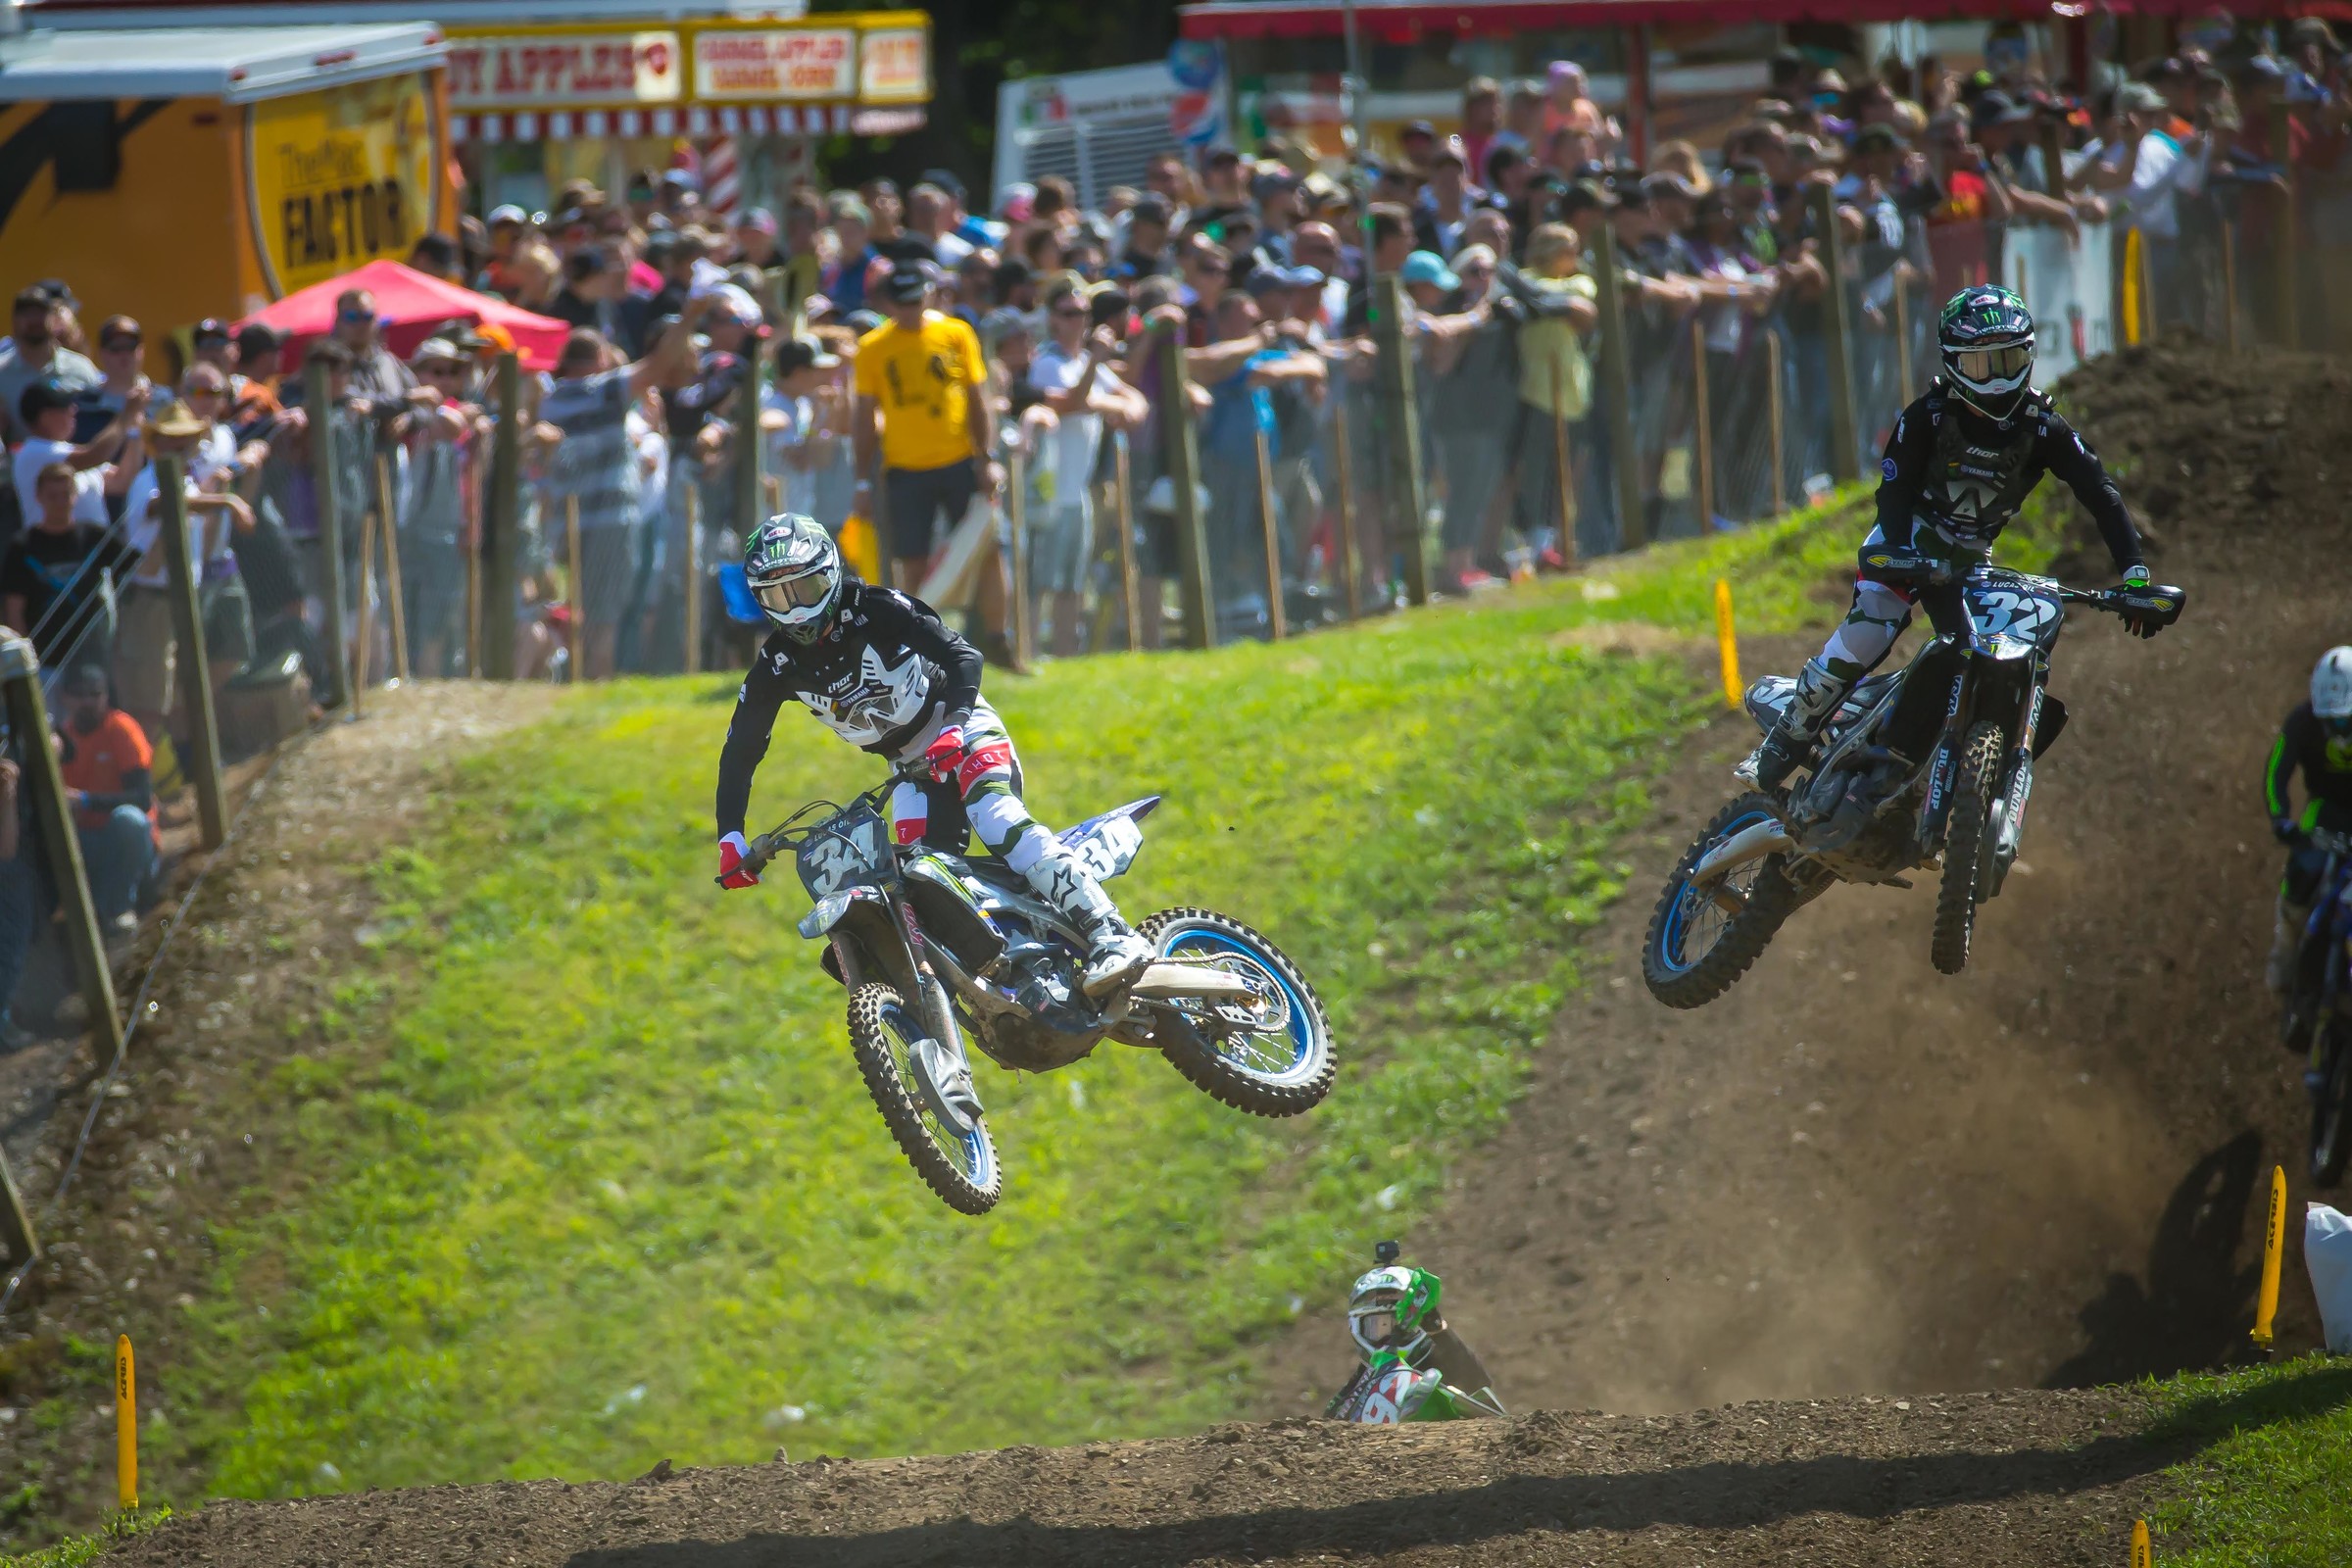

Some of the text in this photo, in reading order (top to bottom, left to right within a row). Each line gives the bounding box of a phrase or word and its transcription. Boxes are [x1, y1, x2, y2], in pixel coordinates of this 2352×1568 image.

[495, 43, 637, 93] APPLES
[281, 175, 409, 270] FACTOR
[1966, 446, 1999, 458] thor
[768, 529, 787, 538] BELL
[1973, 591, 2057, 642] 32
[828, 671, 854, 694] thor
[847, 687, 871, 705] YAMAHA
[810, 820, 878, 896] 34
[1074, 814, 1143, 883] 34
[2268, 1188, 2278, 1250] ACERBIS
